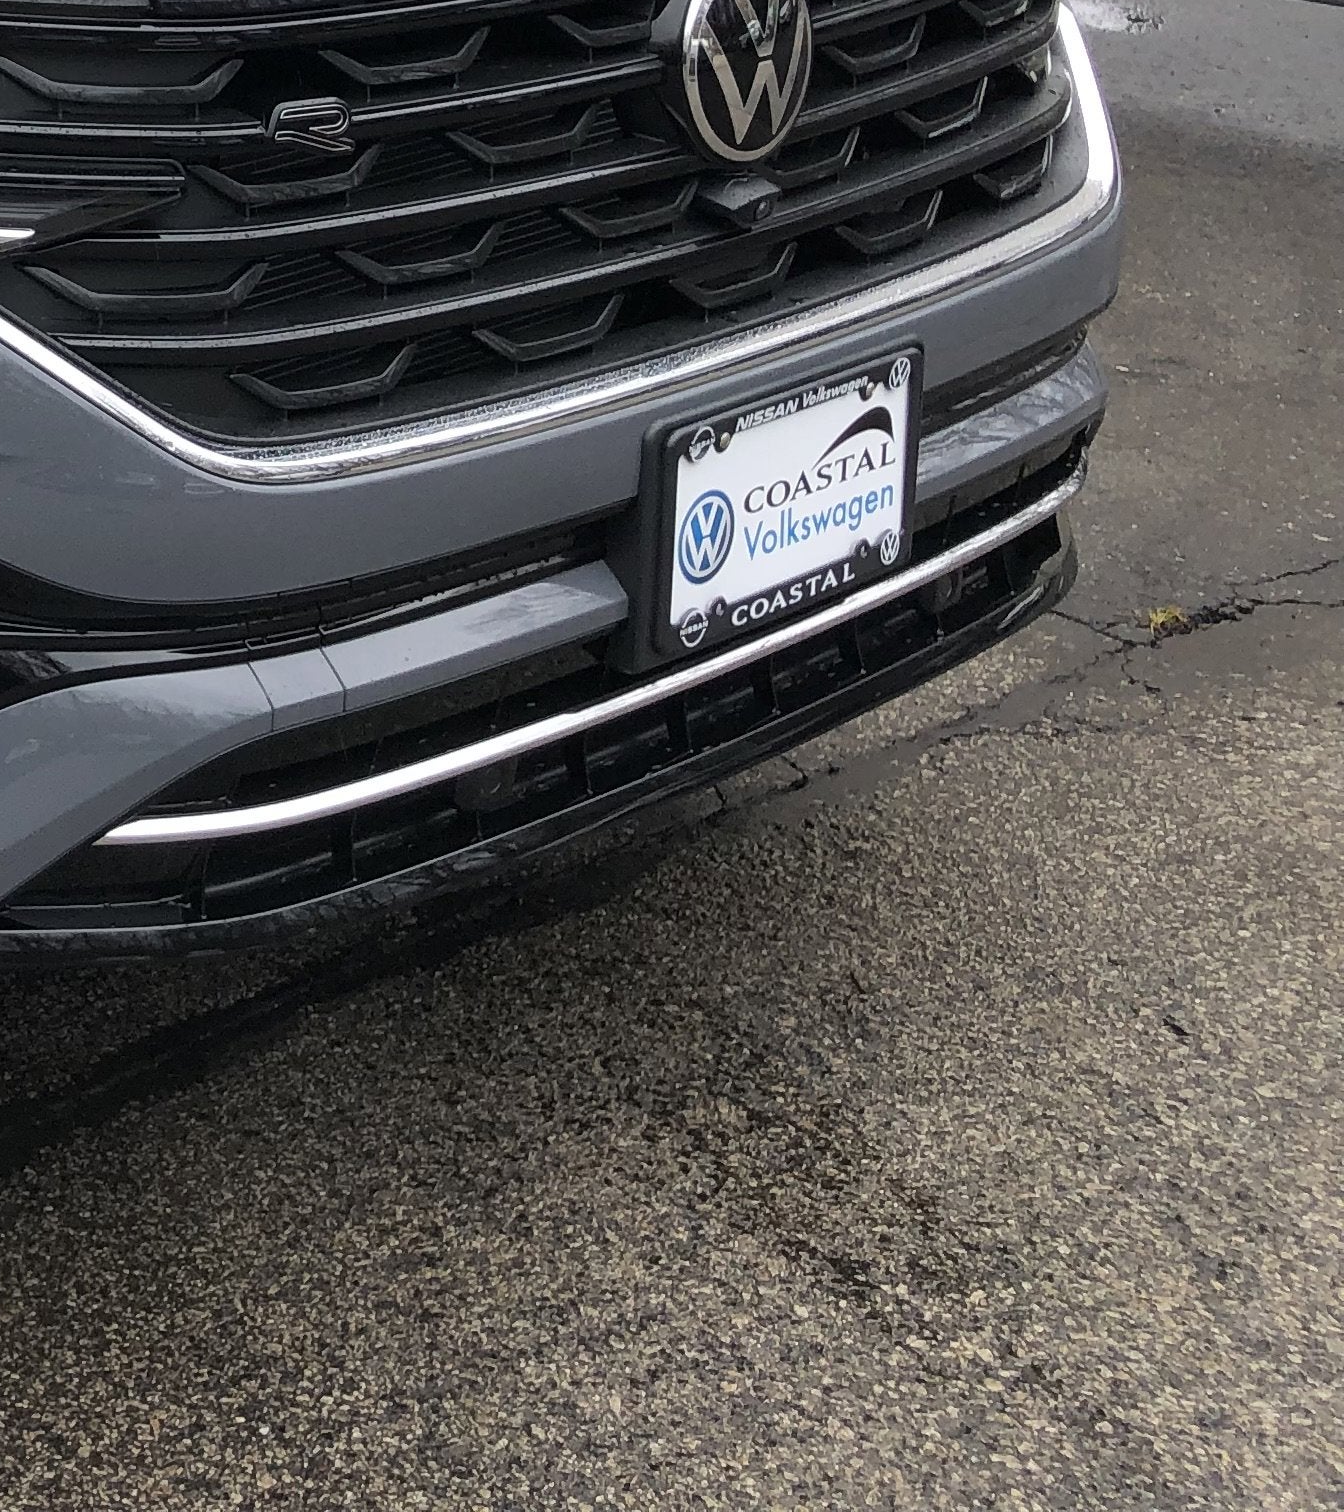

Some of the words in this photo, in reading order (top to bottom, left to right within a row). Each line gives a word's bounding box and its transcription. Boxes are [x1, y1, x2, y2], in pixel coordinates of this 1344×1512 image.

[270, 99, 353, 153] R
[736, 397, 800, 433] NISSAN
[802, 375, 869, 409] Volkswagen
[743, 441, 896, 514] COASTAL
[744, 484, 894, 561] Volkswagen
[731, 561, 856, 627] COASTAL
